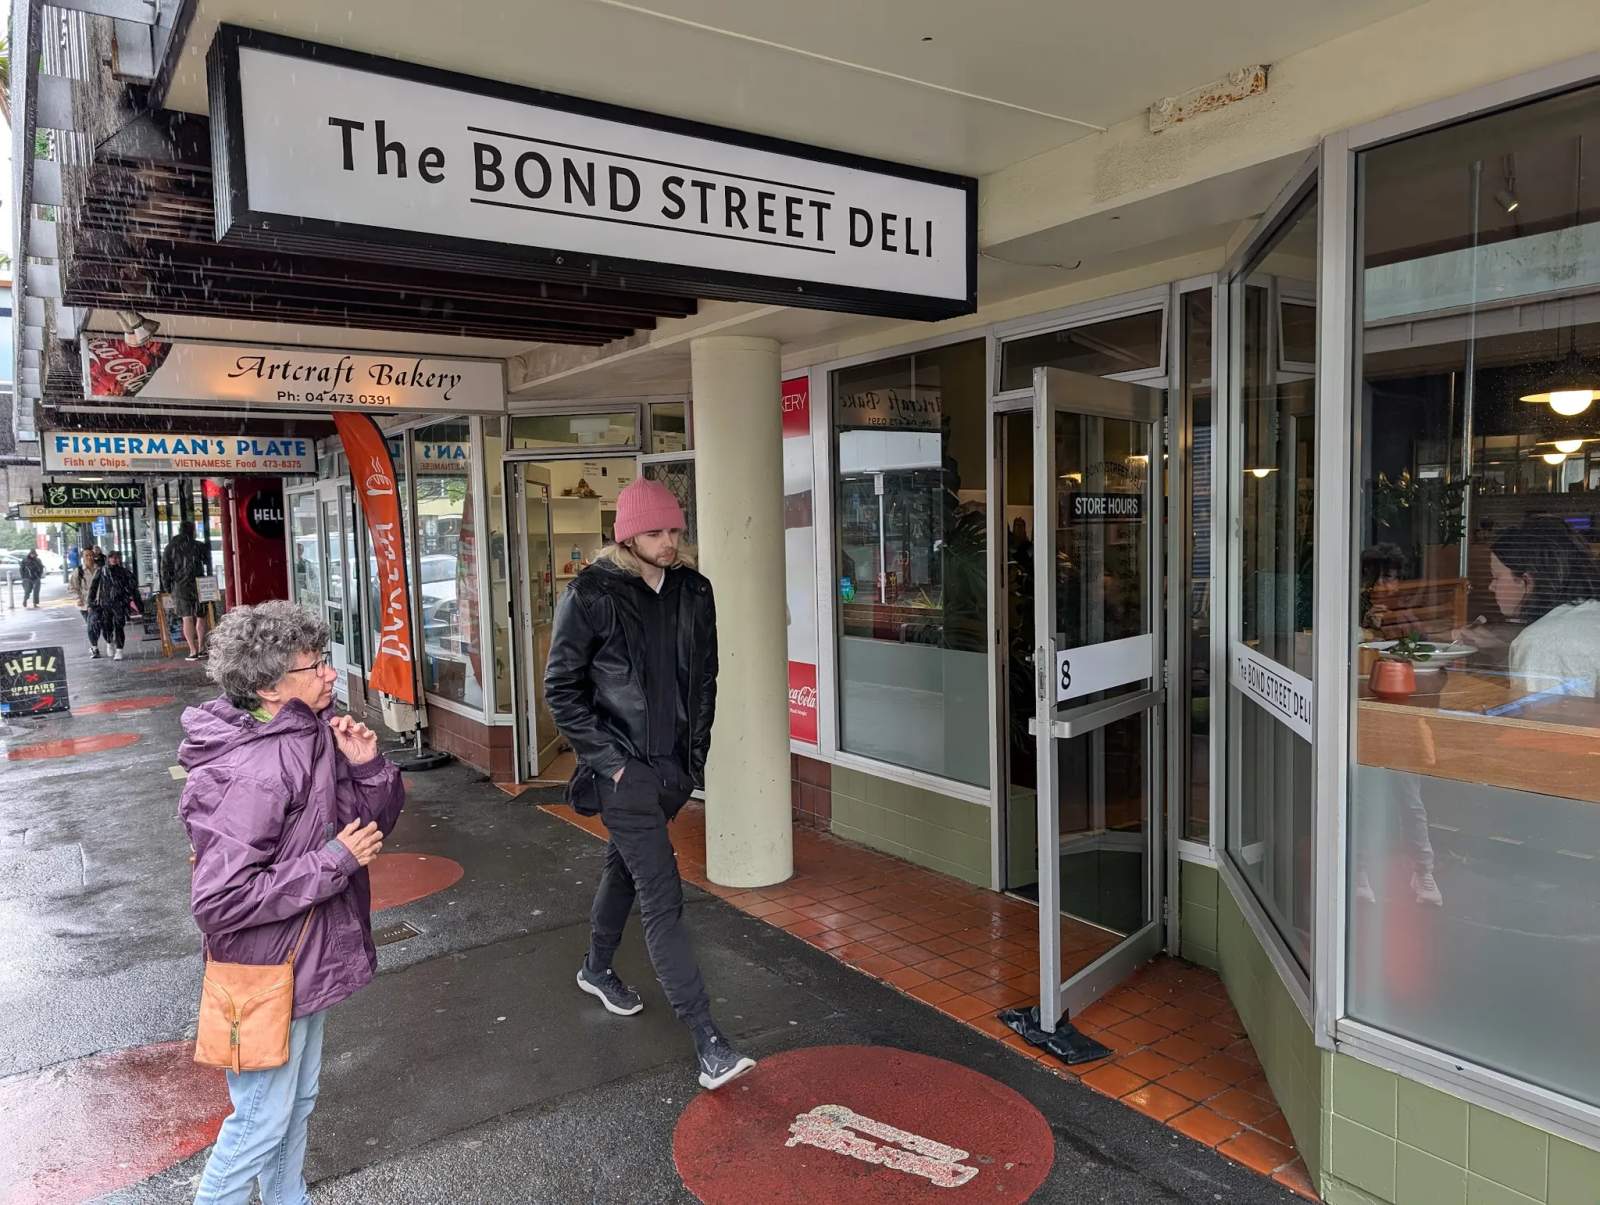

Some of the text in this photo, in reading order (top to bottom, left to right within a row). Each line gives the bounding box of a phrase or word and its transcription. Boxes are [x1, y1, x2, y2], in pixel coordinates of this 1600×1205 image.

[328, 116, 932, 258] The BOND STREET DELI
[227, 355, 462, 401] Artcraft Bakery
[277, 391, 391, 405] Ph: 04 473 0391
[781, 391, 807, 412] KERY
[55, 435, 306, 456] FISHERMAN'S PLATE
[63, 457, 85, 467] Fish
[174, 458, 232, 468] VIETNAMESE
[235, 459, 257, 468] Food
[72, 487, 140, 499] ENVYOUR
[254, 508, 284, 521] HELL
[1075, 497, 1138, 515] STORE HOURS
[5, 655, 56, 676] HELL
[1061, 659, 1071, 690] 8
[1248, 663, 1264, 693] BOND
[1266, 675, 1292, 711] STREET
[1293, 692, 1311, 725] DELI
